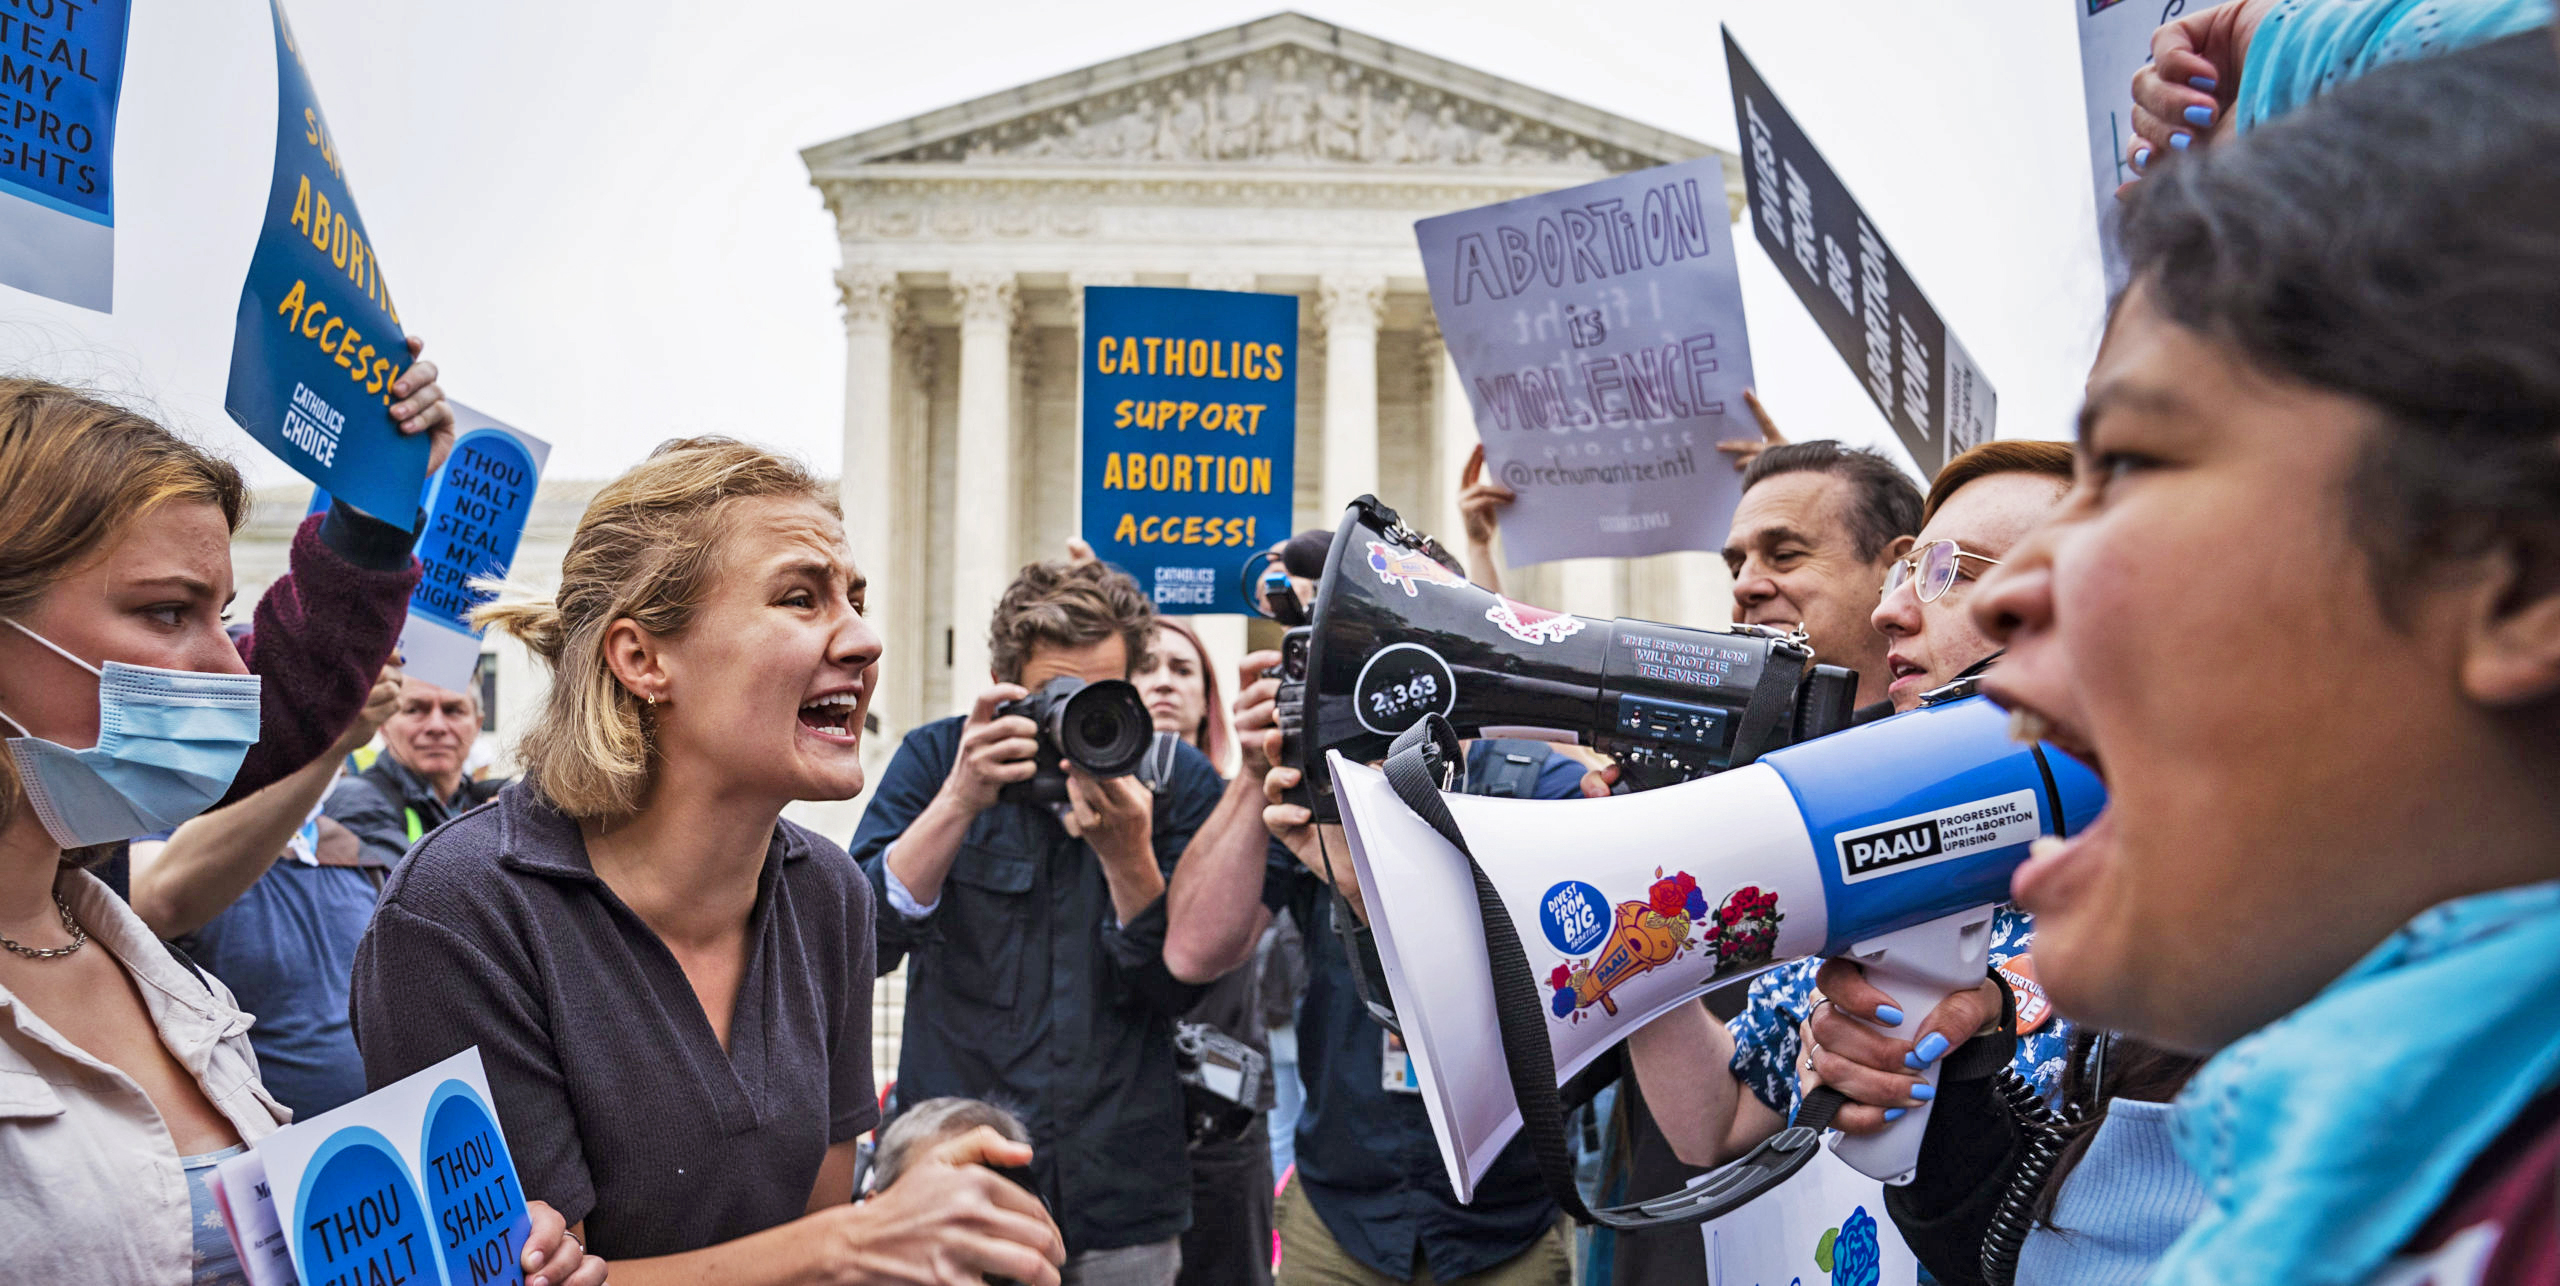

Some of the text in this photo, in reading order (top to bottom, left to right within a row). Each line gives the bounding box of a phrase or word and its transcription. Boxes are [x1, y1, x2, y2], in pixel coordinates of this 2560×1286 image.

[9, 0, 83, 32] OT
[0, 12, 98, 82] TEAL
[2, 54, 62, 101] MY
[1745, 94, 1786, 249] DIVEST
[1783, 157, 1820, 287] FROM
[1824, 232, 1855, 317] BIG
[1564, 303, 1608, 350] is
[1857, 215, 1895, 421] ABORTION
[278, 279, 400, 406] ACCESS!
[1097, 335, 1284, 382] CATHOLICS
[1474, 333, 1725, 431] VIOLENCE
[1899, 312, 1930, 443] NOW!
[292, 381, 346, 435] CATHOLICS
[1114, 400, 1268, 435] SUPPORT
[281, 410, 338, 469] CHOICE
[463, 446, 524, 488] THOU
[1103, 452, 1272, 494] ABORTION
[1501, 449, 1698, 494] @rehumanizeintl
[449, 468, 520, 511] SHALT
[455, 495, 500, 528] NOT
[1114, 513, 1256, 547] ACCESS!
[436, 513, 500, 556] STEAL
[445, 543, 481, 568] MY
[1154, 566, 1216, 583] CATHOLICS
[1154, 587, 1216, 604] CHOICE
[414, 580, 471, 615] RIGHT
[1621, 633, 1748, 663] THE REVOLUION
[1634, 648, 1730, 674] WILL NOT BE
[1369, 674, 1438, 713] 2,363
[1639, 662, 1720, 687] TELEVISED
[1851, 801, 2016, 868] PAAU PROGRESSIVE
[1941, 810, 2033, 841] ANTI-ABORTION
[1944, 831, 1998, 852] UPRISING
[1547, 882, 1578, 914] DIVEST
[1555, 891, 1586, 926] FROM
[1563, 904, 1595, 944] BIG
[1570, 921, 1601, 950] ABORTION
[1596, 948, 1629, 983] PAAU
[1999, 967, 2048, 1000] OVERTUR
[2013, 989, 2047, 1023] OE
[431, 1130, 494, 1195] THOU
[309, 1182, 400, 1265] THOU
[442, 1174, 512, 1250] SHALT
[467, 1227, 515, 1281] NOT
